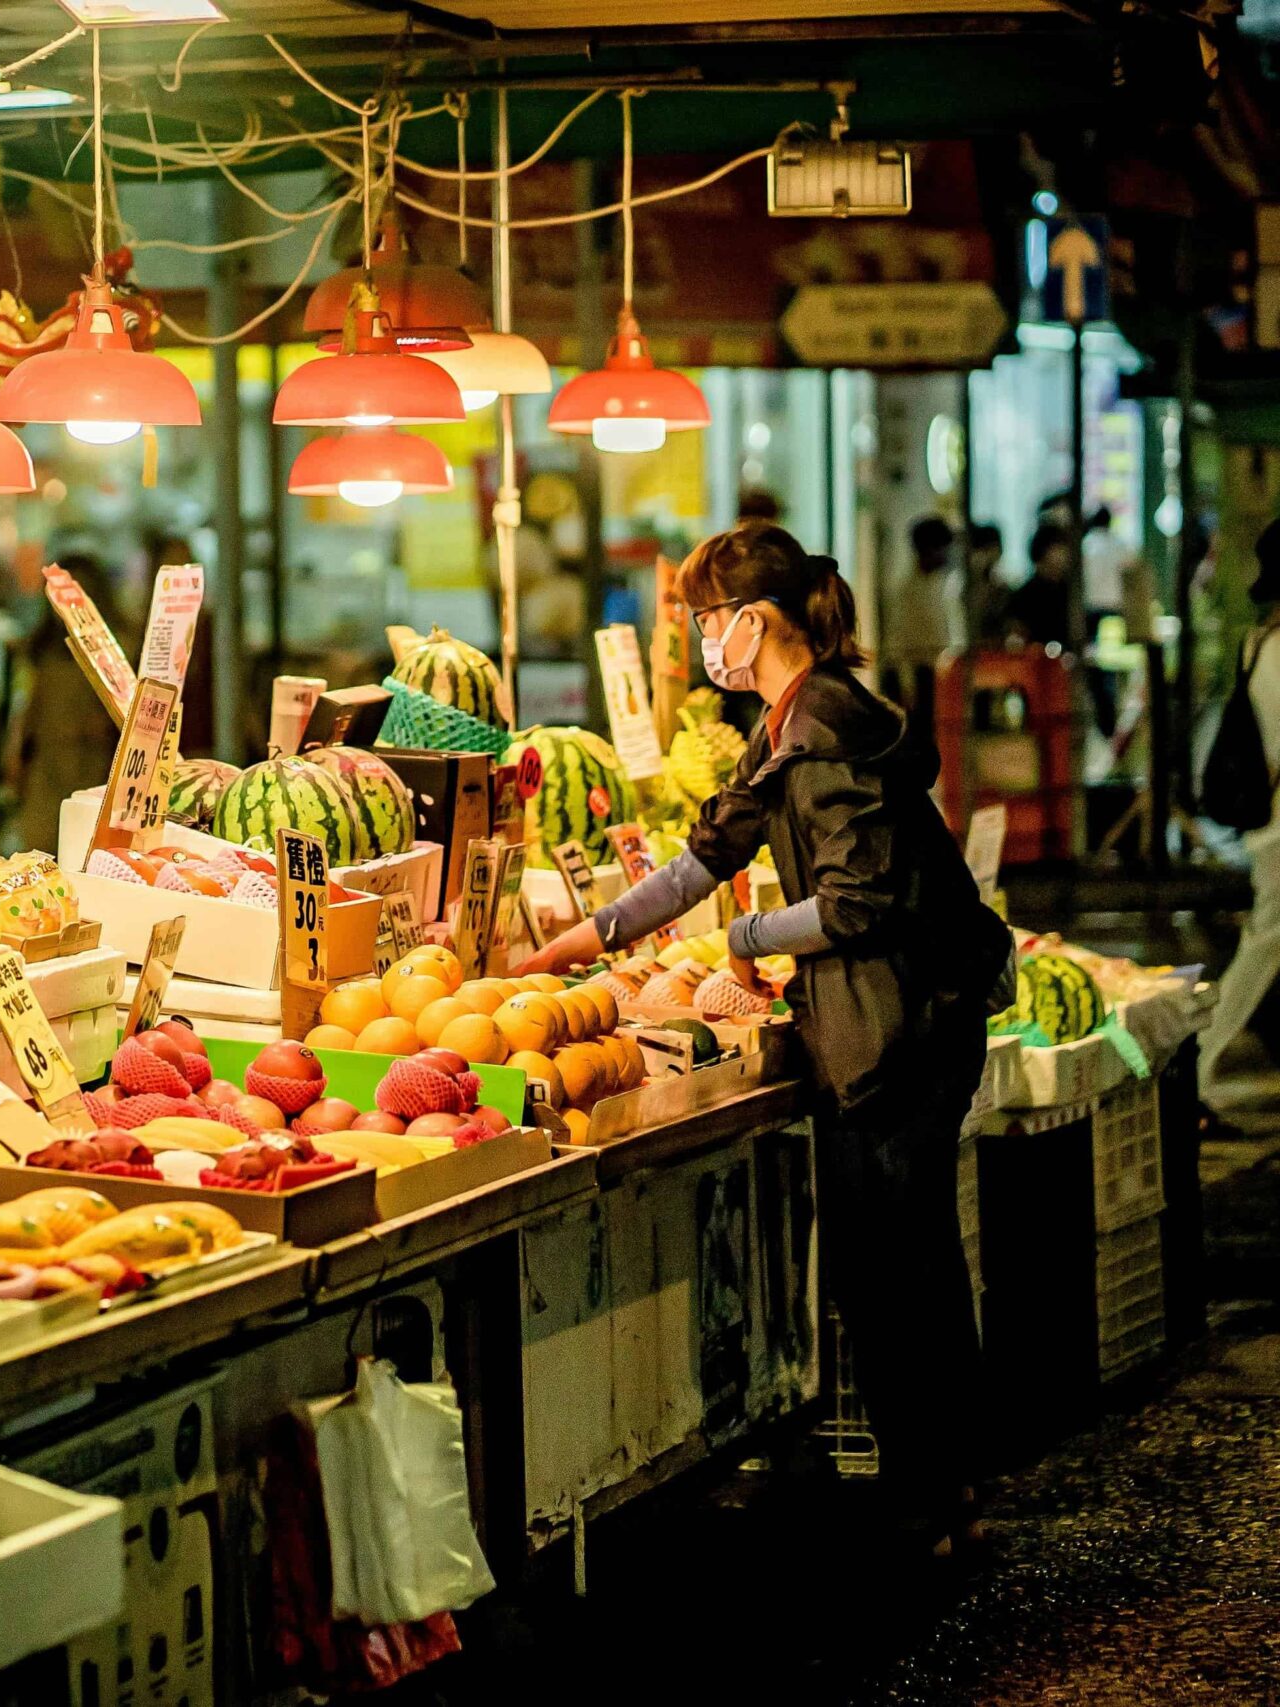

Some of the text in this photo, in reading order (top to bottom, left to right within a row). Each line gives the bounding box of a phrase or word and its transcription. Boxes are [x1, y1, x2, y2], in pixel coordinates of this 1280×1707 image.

[122, 748, 145, 780] 100
[522, 757, 540, 788] 100
[121, 786, 135, 821] 3
[140, 793, 159, 829] 38
[285, 836, 326, 887] 舊橙
[295, 890, 317, 932] 30
[308, 938, 319, 982] 3
[2, 988, 33, 1019] 水仙芒
[23, 1037, 49, 1079] 48
